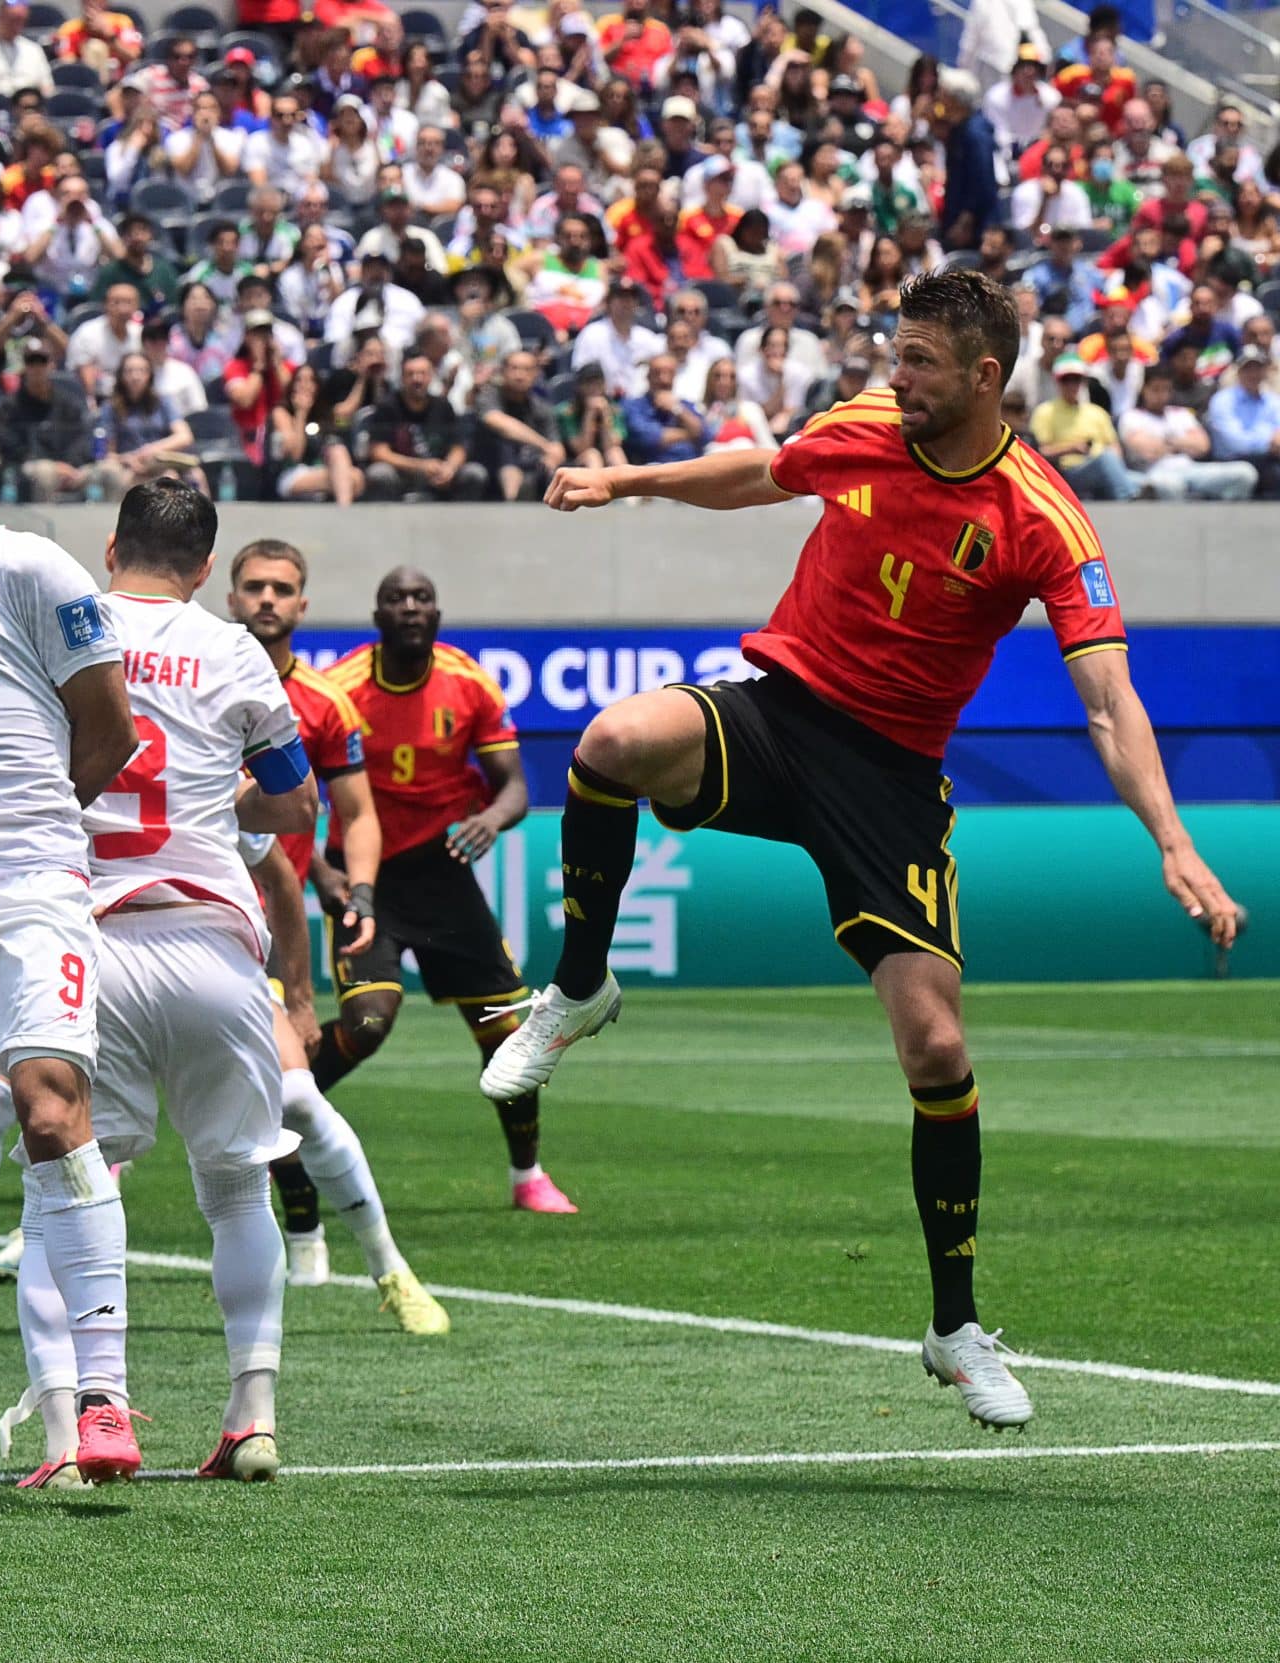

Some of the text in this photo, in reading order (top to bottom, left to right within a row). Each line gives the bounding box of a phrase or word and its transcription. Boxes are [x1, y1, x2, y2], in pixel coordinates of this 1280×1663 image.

[879, 553, 913, 619] 4
[540, 647, 685, 710] CUP
[391, 743, 416, 785] 9
[907, 863, 937, 926] 4
[58, 952, 86, 1008] 9
